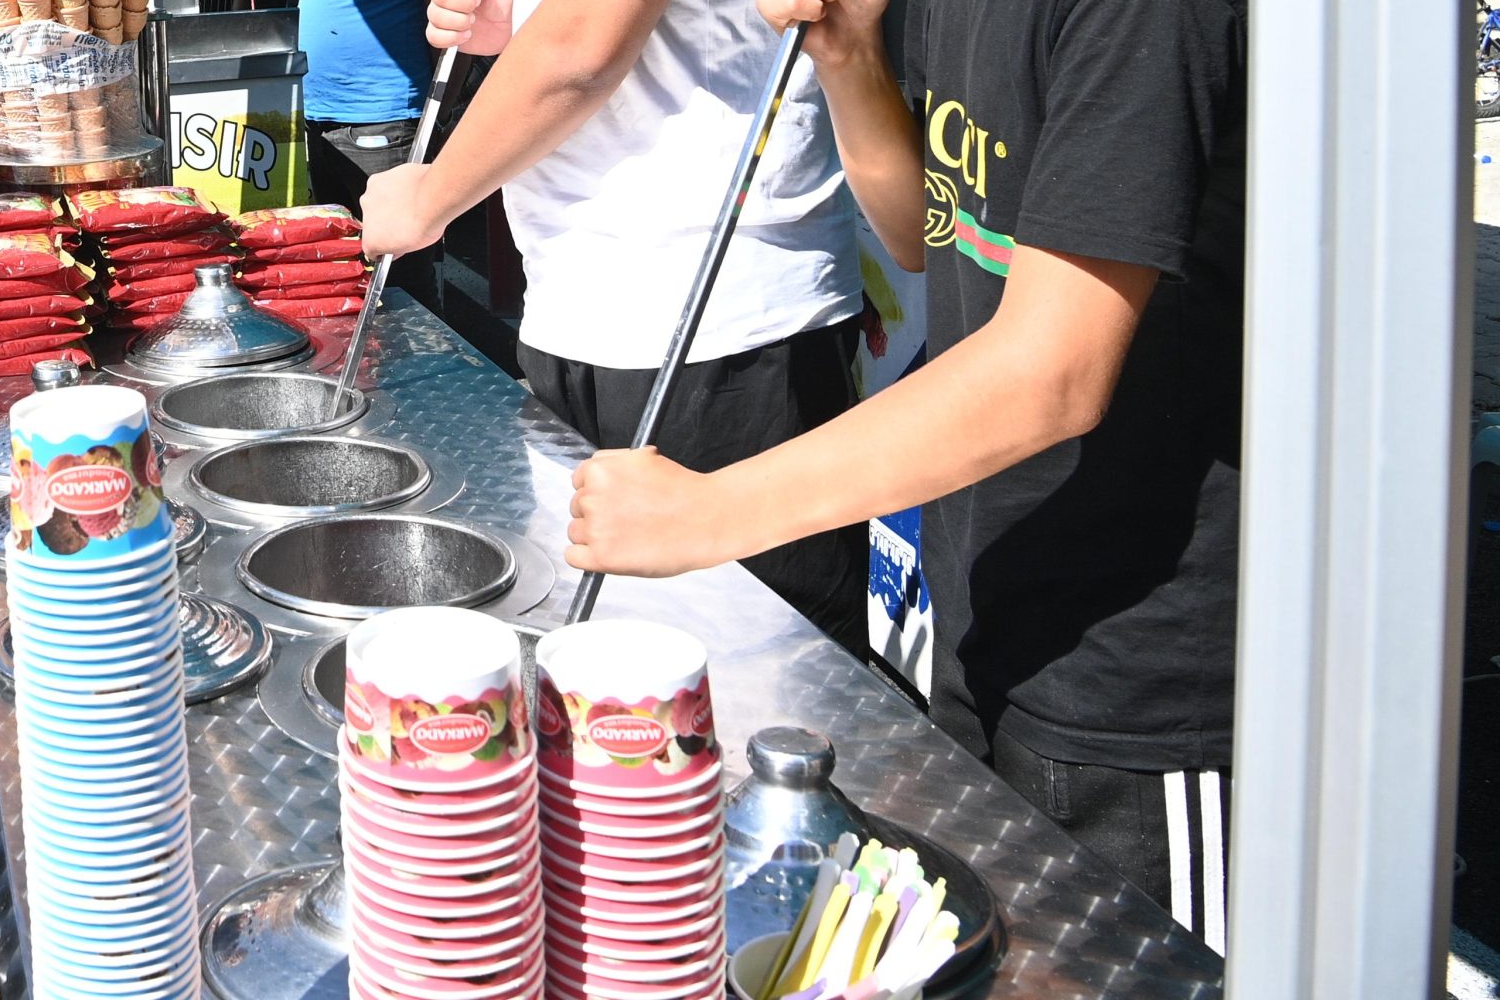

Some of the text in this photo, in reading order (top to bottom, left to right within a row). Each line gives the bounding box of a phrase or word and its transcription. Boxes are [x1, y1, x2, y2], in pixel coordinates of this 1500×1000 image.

[170, 112, 278, 191] ISIR
[51, 477, 127, 498] MARKADO
[416, 722, 487, 741] MARKADO
[592, 725, 662, 742] MARKADO
